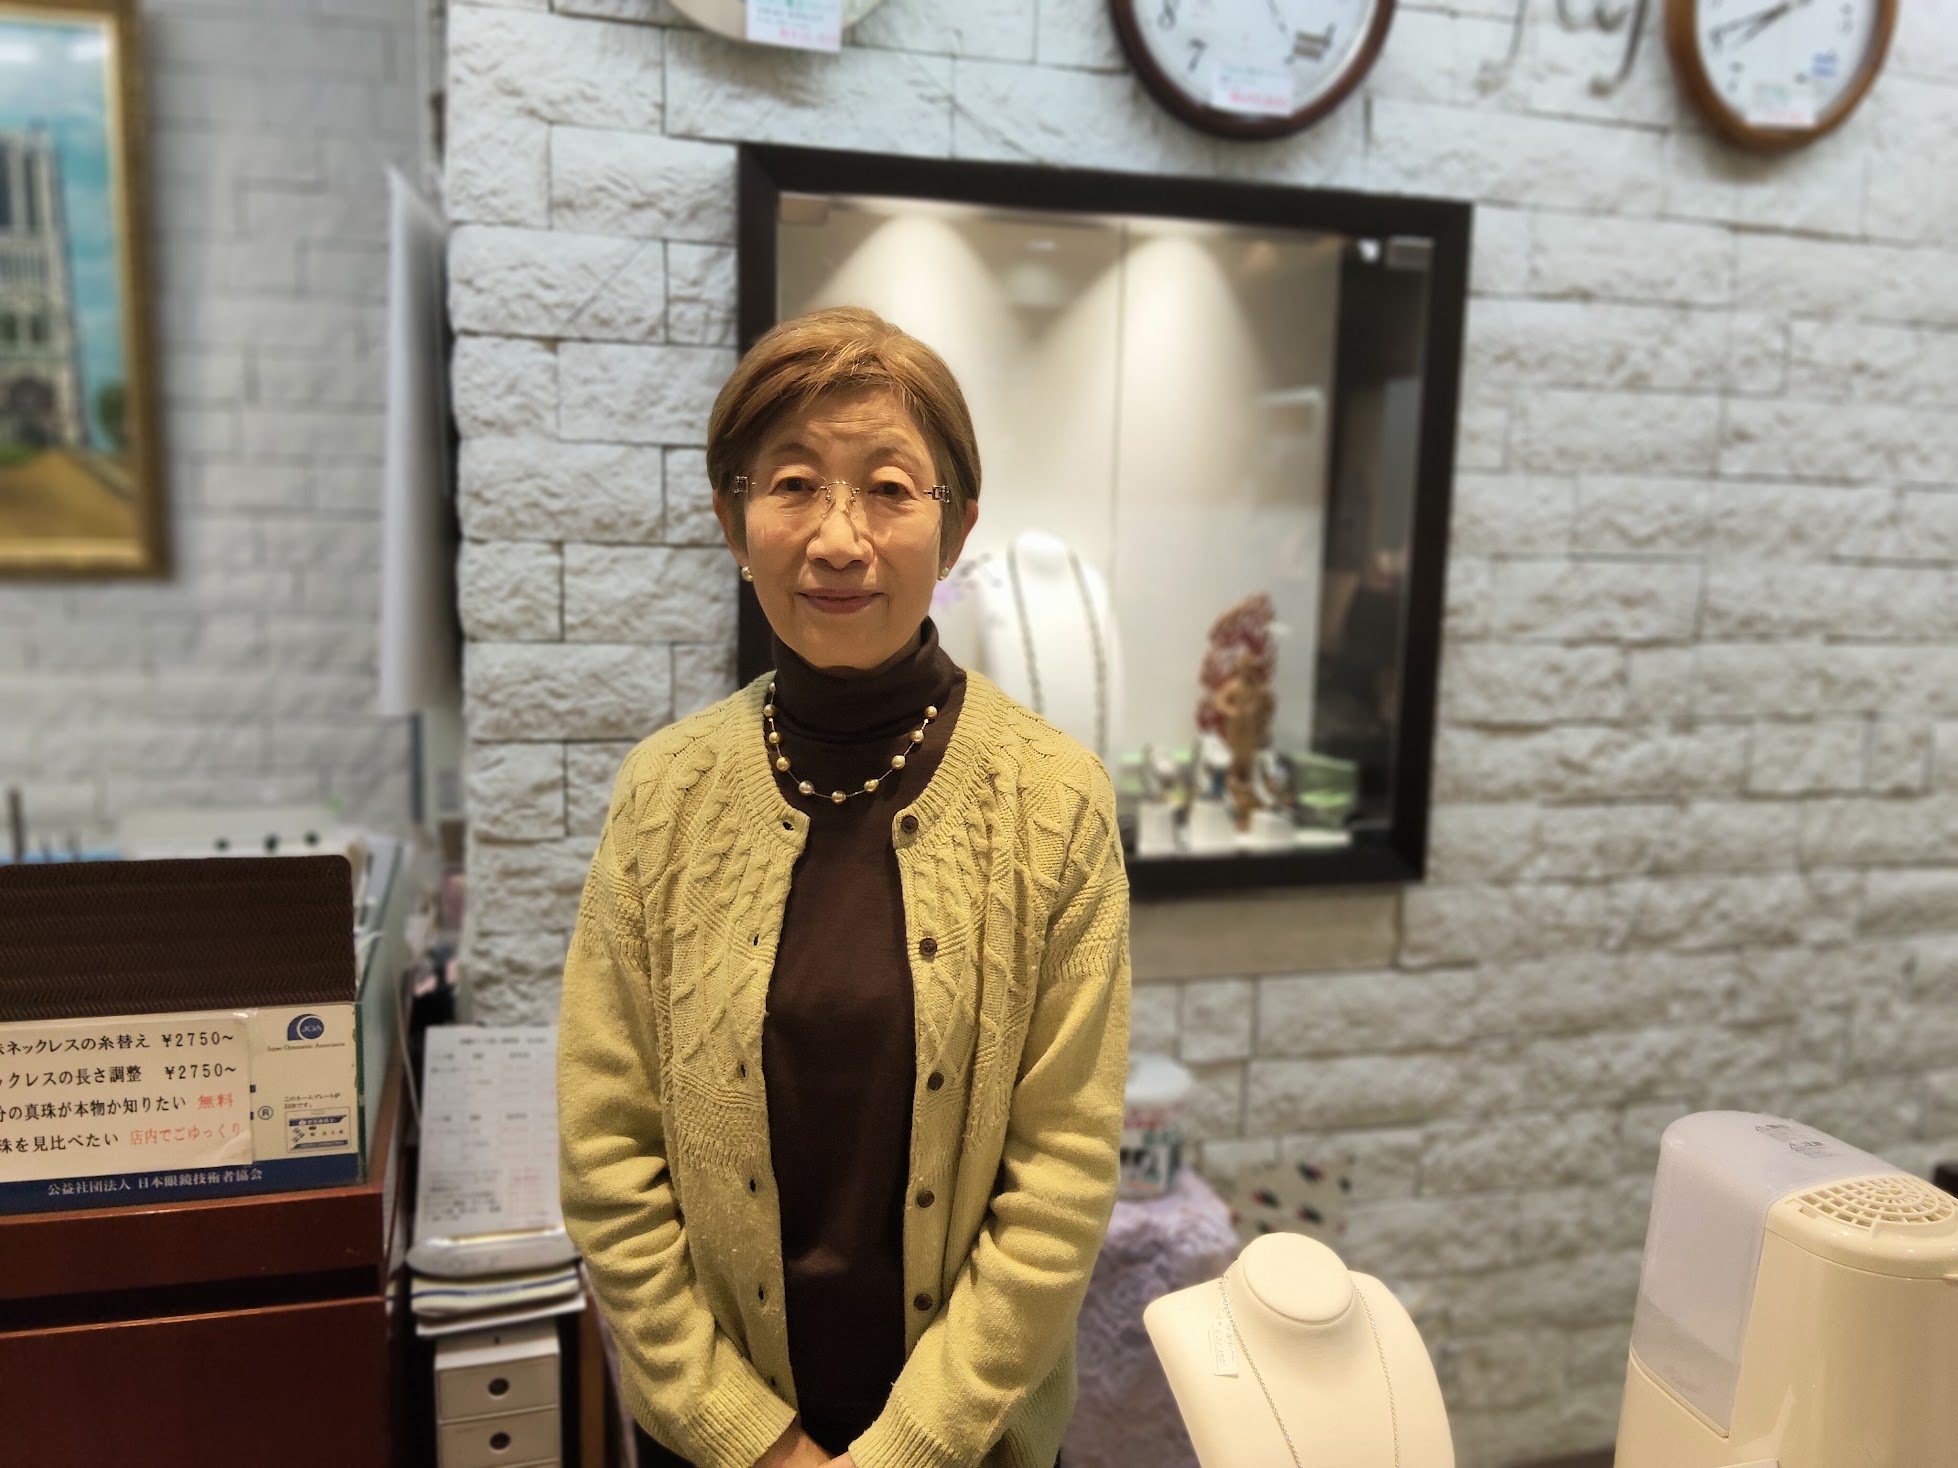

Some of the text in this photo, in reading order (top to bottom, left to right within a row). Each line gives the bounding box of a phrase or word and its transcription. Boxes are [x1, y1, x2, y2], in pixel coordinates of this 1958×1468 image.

[0, 1064, 143, 1089] クレスの長さ調整
[197, 1092, 235, 1110] 無料
